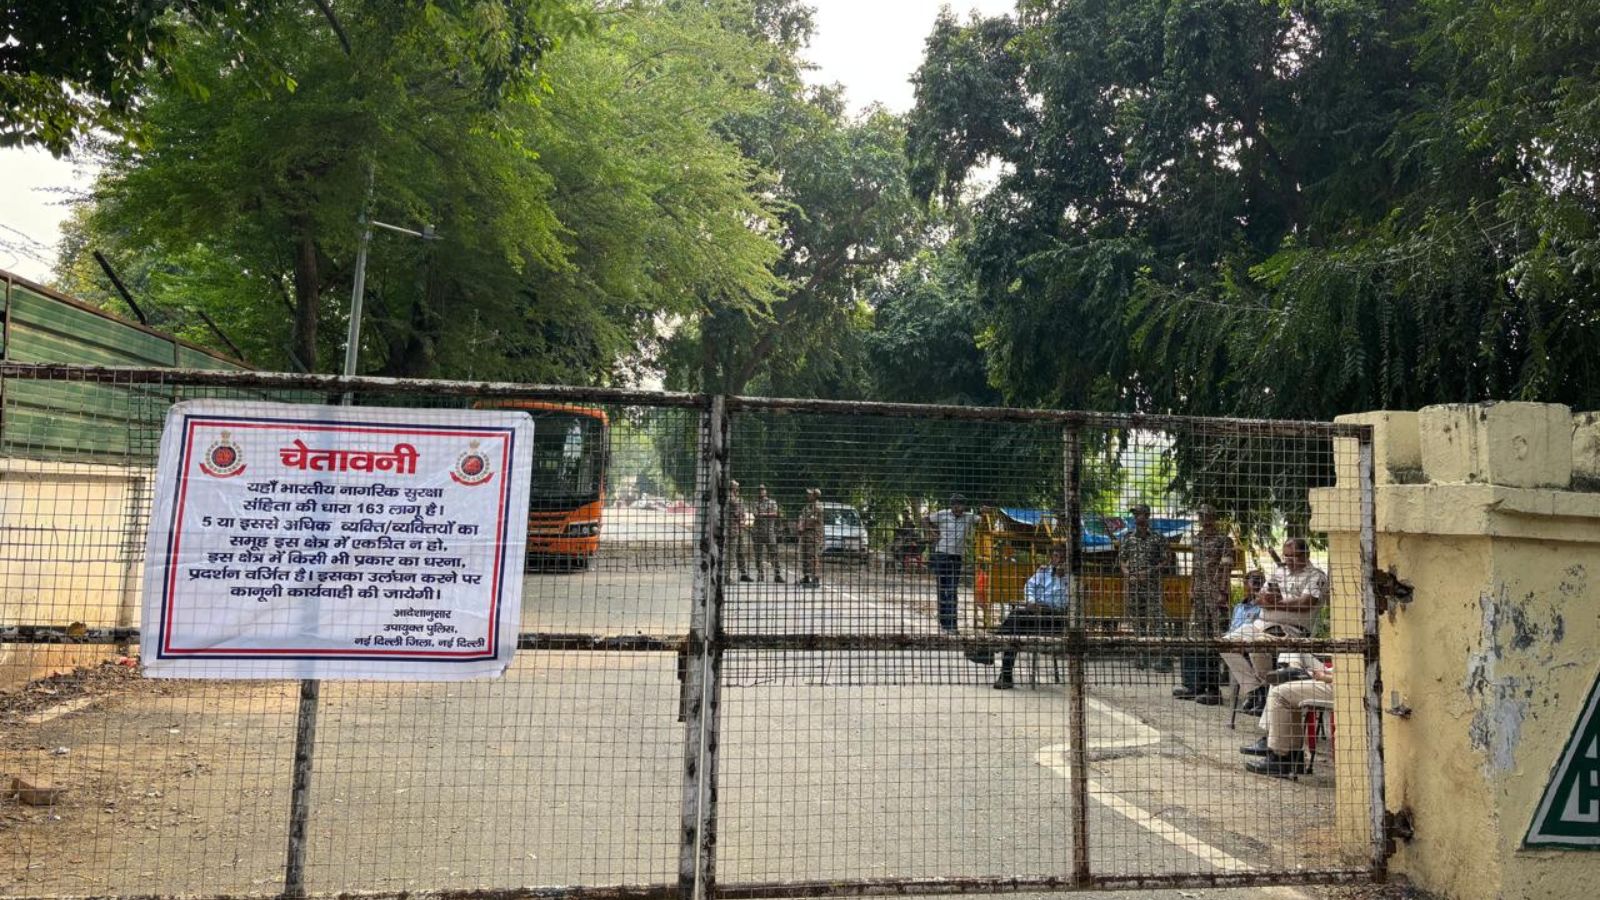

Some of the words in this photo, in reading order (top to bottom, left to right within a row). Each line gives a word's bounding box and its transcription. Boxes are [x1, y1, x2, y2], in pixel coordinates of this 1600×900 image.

[280, 439, 420, 474] चेतावनी
[247, 480, 278, 493] यहाँ
[281, 481, 335, 494] भारतीय
[340, 483, 400, 497] नागरिक
[404, 487, 444, 502] सुरक्षा
[243, 497, 291, 512] संहिता
[296, 499, 317, 512] की
[321, 503, 351, 514] धारा
[357, 503, 384, 514] 163
[389, 505, 424, 521] लागू
[202, 516, 212, 527] 5
[217, 517, 235, 528] या
[240, 516, 279, 530] इससे
[283, 516, 333, 531] अधिक
[458, 525, 479, 535] का
[229, 536, 270, 551] समूह
[274, 537, 300, 548] इस
[304, 535, 330, 548] क्षेत्र
[333, 536, 350, 549] में
[352, 536, 405, 550] एकत्रित
[409, 540, 423, 550] न
[207, 552, 234, 563] इस
[238, 550, 264, 563] क्षेत्र
[269, 551, 286, 564] में
[288, 550, 327, 565] किसी
[331, 551, 350, 565] भी
[354, 555, 396, 567] प्रकार
[398, 556, 420, 567] का
[424, 557, 466, 568] धरना,
[189, 566, 241, 581] प्रदर्शन
[245, 566, 290, 581] वर्जित
[317, 571, 363, 582] इसका
[421, 571, 458, 584] करने
[462, 574, 483, 584] पर
[230, 583, 283, 602] कानूनी
[287, 584, 353, 599] कार्यवाही
[358, 585, 379, 599] की
[393, 607, 452, 622] आदेशानुसार
[383, 624, 424, 636] उपायुक्त
[354, 635, 370, 646] नई
[374, 635, 403, 647] दिल्ली
[438, 637, 454, 648] नई
[456, 637, 485, 648] दिल्ली
